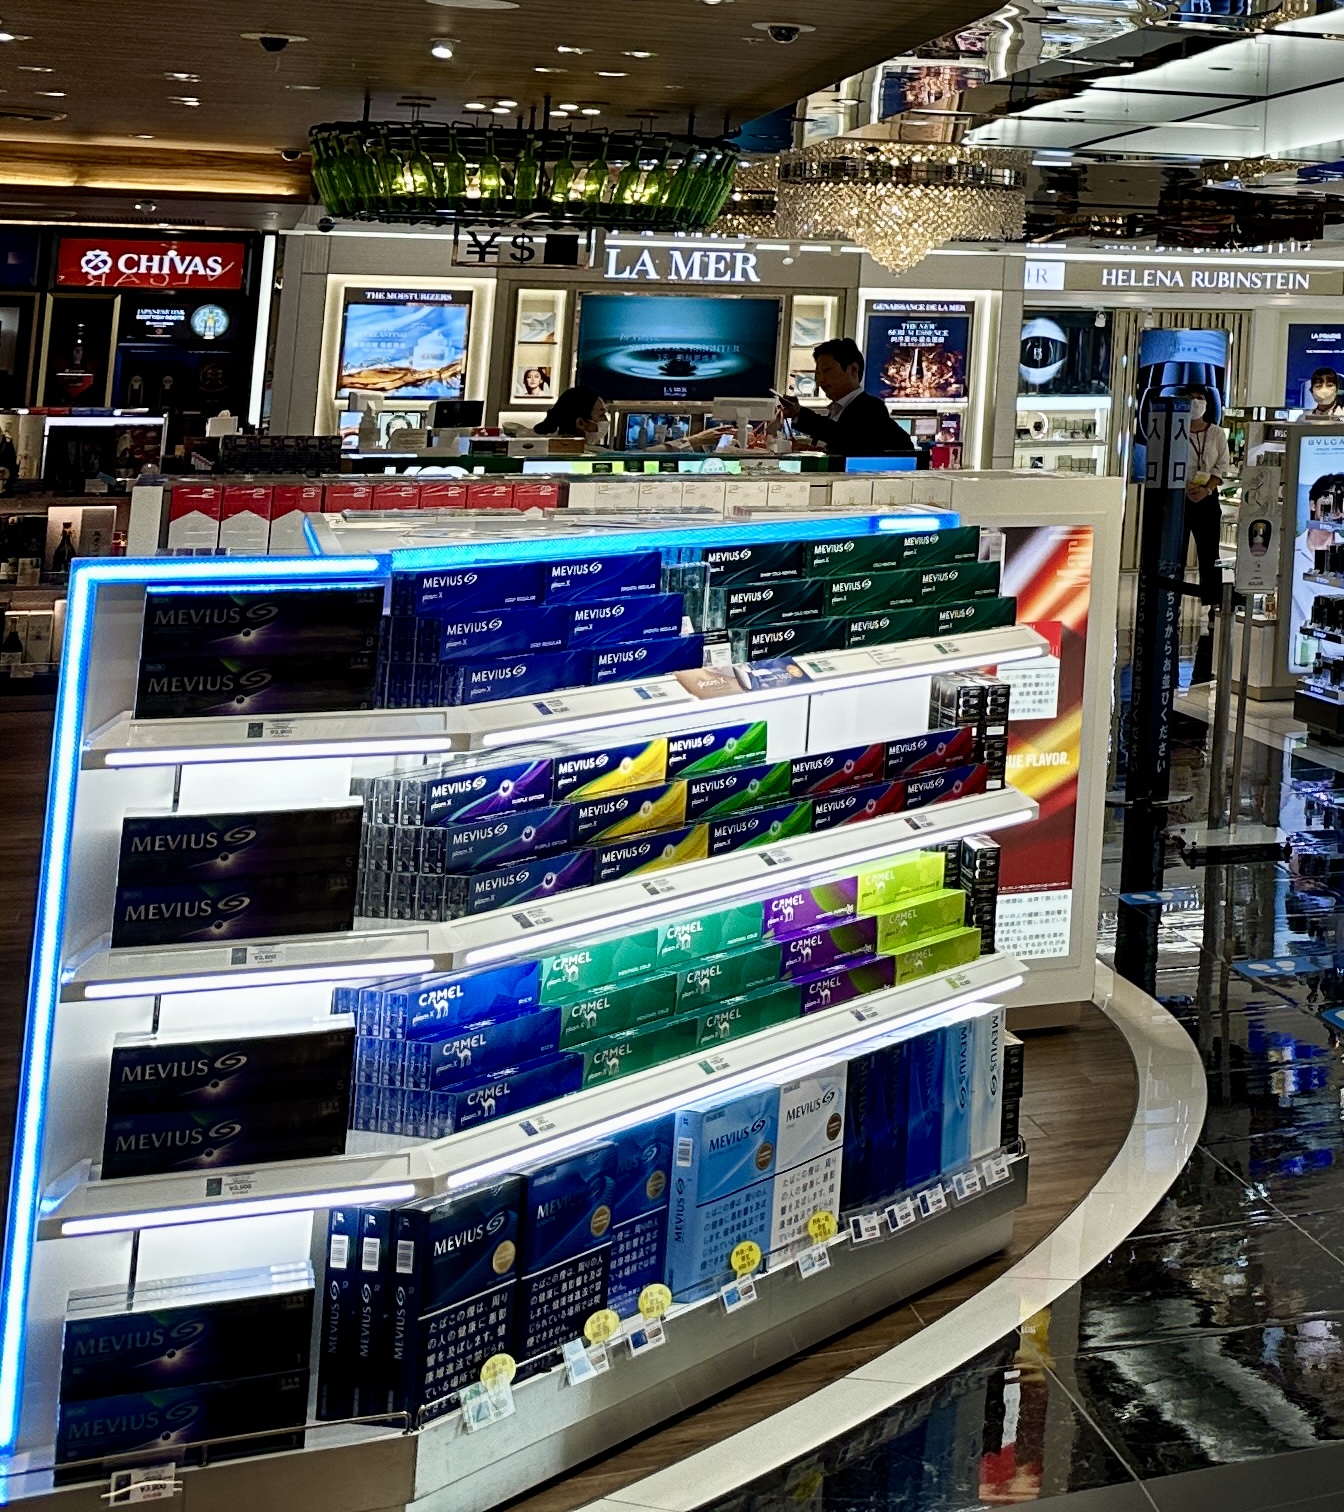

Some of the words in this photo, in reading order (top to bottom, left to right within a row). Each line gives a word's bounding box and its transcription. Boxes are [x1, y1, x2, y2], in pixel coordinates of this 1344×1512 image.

[117, 253, 223, 276] CHIVAS
[604, 248, 660, 279] LA
[668, 251, 760, 282] MER
[1102, 268, 1184, 288] HELENA
[1191, 270, 1310, 290] RUBINSTEIN
[708, 551, 740, 562] MEVIUS
[551, 564, 589, 578] MEVIUS
[423, 574, 463, 589] MEVIUS
[730, 592, 762, 604] MEVIUS
[154, 607, 240, 625] MEVIUS
[574, 607, 612, 621] MEVIUS
[447, 621, 488, 636] MEVIUS
[752, 632, 784, 644] MEVIUS
[598, 650, 634, 665] MEVIUS
[148, 674, 234, 693] MEVIUS
[471, 667, 512, 683] MEVIUS
[1156, 574, 1176, 774] ちらからお並びください
[669, 737, 702, 751] MEVIUS
[558, 758, 595, 774] MEVIUS
[432, 780, 471, 797] MEVIUS
[692, 779, 725, 794] MEVIUS
[579, 802, 615, 817] MEVIUS
[453, 827, 493, 844] MEVIUS
[714, 822, 746, 837] MEVIUS
[131, 832, 218, 853] MEVIUS
[602, 847, 638, 863] MEVIUS
[475, 875, 515, 893] MEVIUS
[125, 899, 212, 921] MEVIUS
[772, 895, 804, 911] CAMEL
[667, 921, 703, 939] CAMEL
[790, 935, 822, 952] CAMEL
[552, 952, 592, 971] CAMEL
[687, 966, 722, 984] CAMEL
[809, 977, 841, 994] CAMEL
[419, 985, 464, 1007] CAMEL
[571, 998, 611, 1019] CAMEL
[707, 1009, 741, 1028] CAMEL
[442, 1035, 487, 1056] CAMEL
[989, 1016, 999, 1072] MEVIUS
[594, 1044, 633, 1064] CAMEL
[959, 1027, 967, 1083] MEVIUS
[121, 1059, 209, 1082] MEVIUS
[467, 1083, 511, 1105] CAMEL
[786, 1098, 821, 1122] MEVIUS
[115, 1128, 203, 1152] MEVIUS
[709, 1131, 750, 1152] MEVIUS
[675, 1198, 686, 1243] MEVIUS
[434, 1224, 484, 1256] MEVIUS
[328, 1303, 340, 1354] MEVIUS
[360, 1306, 372, 1357] MEVIUS
[394, 1309, 406, 1360] MEVIUS
[73, 1329, 164, 1357] MEVIUS
[68, 1411, 159, 1438] MEVIUS
